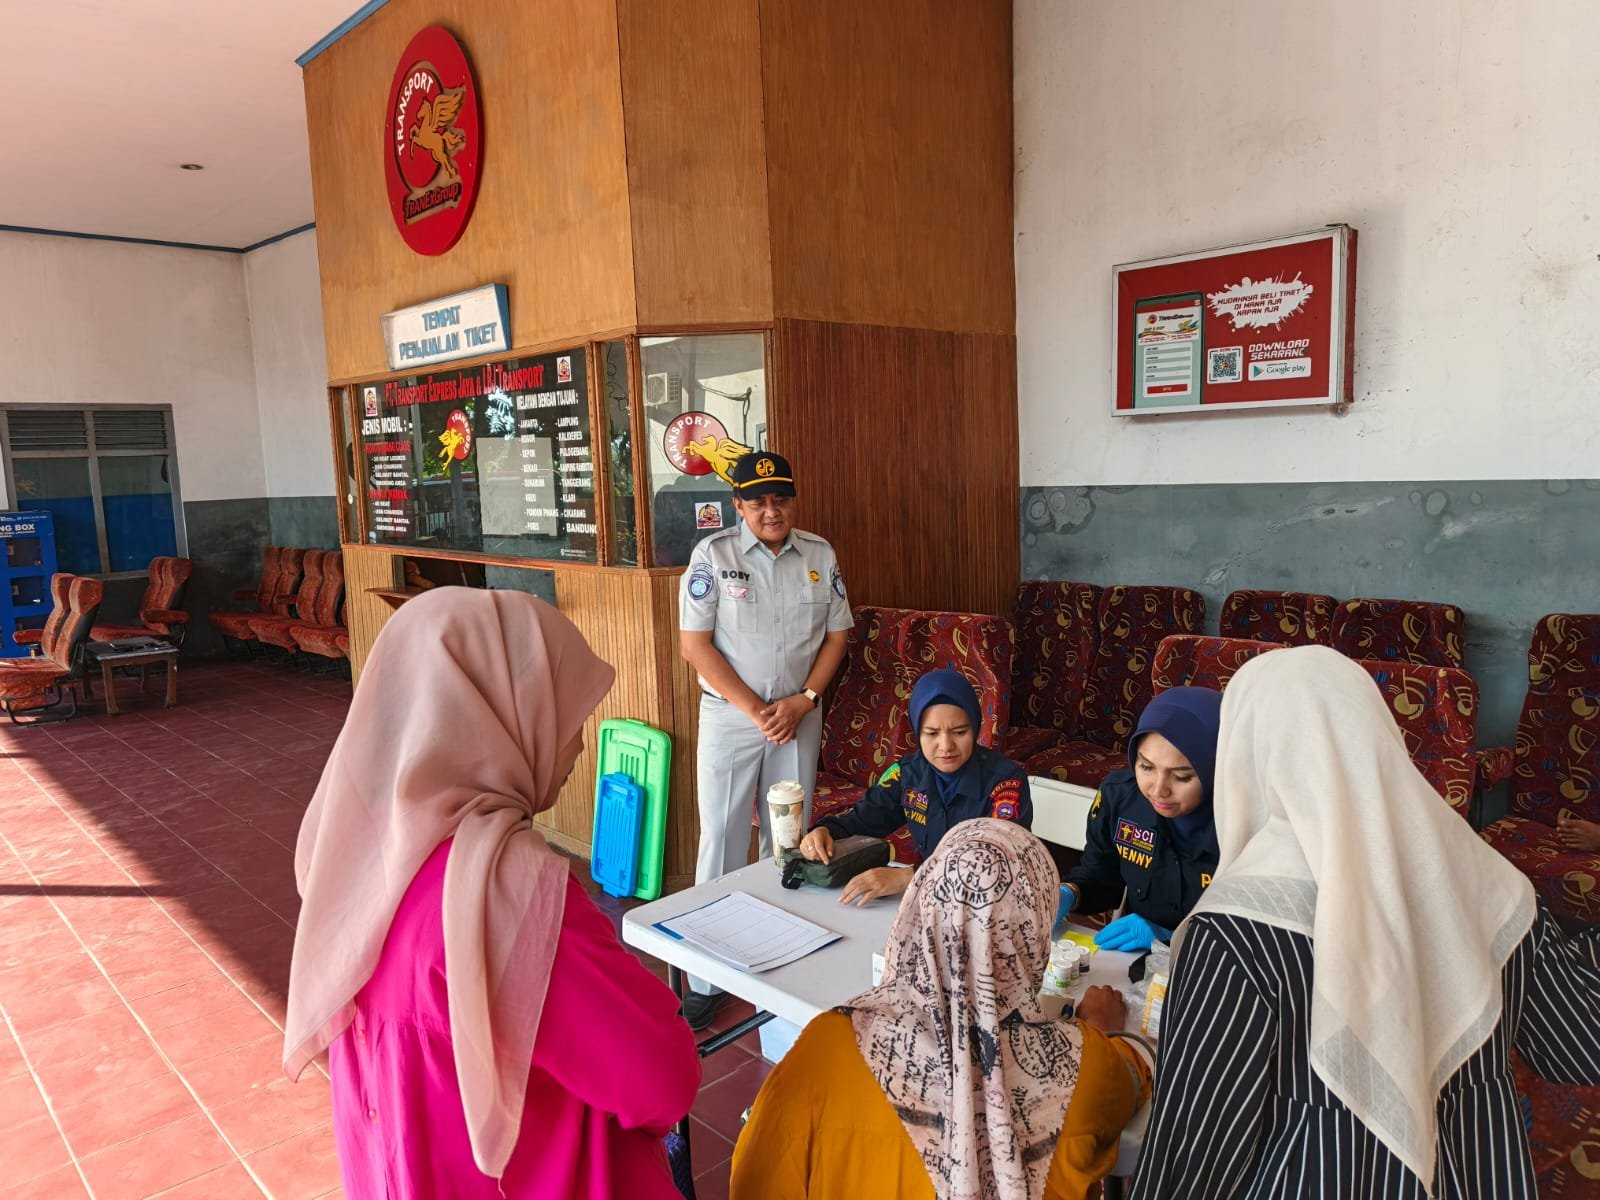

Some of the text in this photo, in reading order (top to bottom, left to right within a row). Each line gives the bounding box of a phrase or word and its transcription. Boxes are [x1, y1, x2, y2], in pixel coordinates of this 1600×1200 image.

[397, 71, 434, 156] TRANSPORT
[1217, 294, 1258, 305] MUDAHNYA
[1280, 288, 1301, 297] TIKET
[1244, 301, 1265, 309] MANA
[1267, 298, 1282, 306] AJA
[422, 305, 461, 332] TEMPAT
[1237, 308, 1262, 317] KAPAN
[399, 322, 497, 360] PENJUALAN TIKET
[1248, 339, 1310, 352] DOWNLOAD
[1266, 366, 1291, 375] Google
[362, 419, 380, 435] JENIS
[381, 416, 403, 433] MOBIL
[451, 412, 470, 454] TRANSPORT
[668, 416, 711, 469] TRANSPORT
[15, 523, 36, 531] BOX
[722, 570, 750, 581] BOBY
[1133, 827, 1154, 844] SCI
